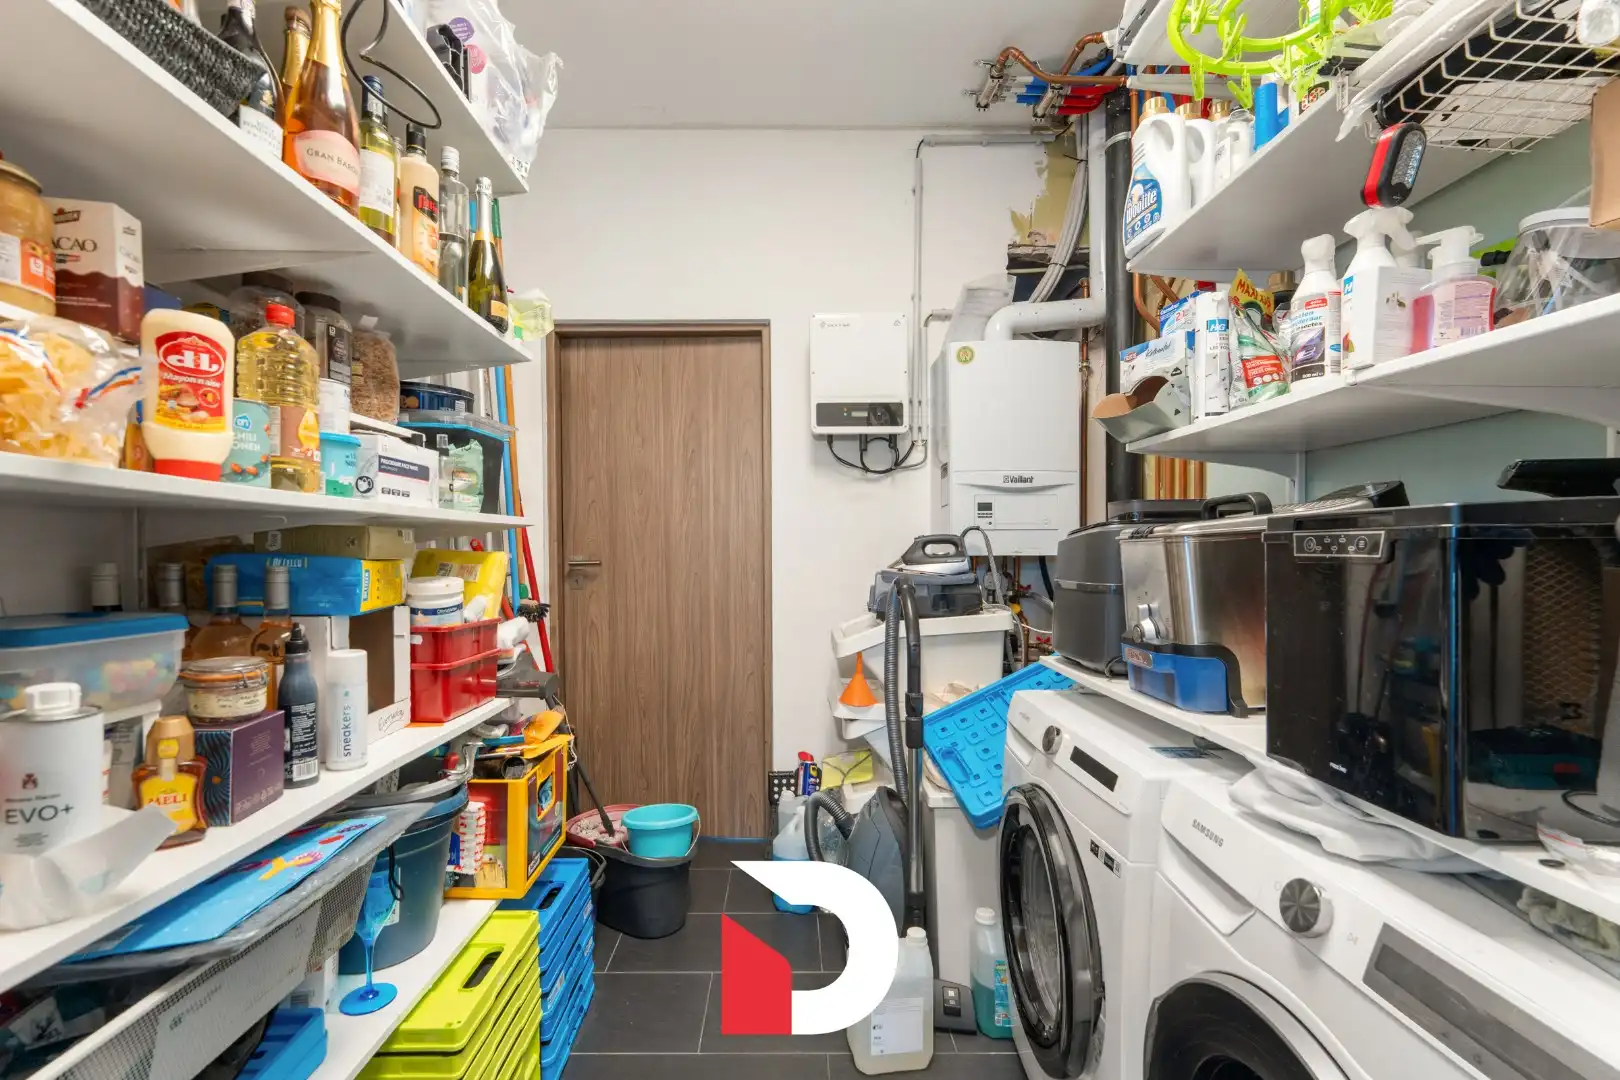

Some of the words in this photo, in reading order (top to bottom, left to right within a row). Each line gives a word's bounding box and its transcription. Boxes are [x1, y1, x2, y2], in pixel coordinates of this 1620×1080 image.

[307, 148, 335, 162] GRAN
[1009, 475, 1034, 484] Vaillant
[341, 704, 352, 758] sneakers
[5, 804, 74, 825] EVO+
[1191, 818, 1225, 848] SAMSUNG
